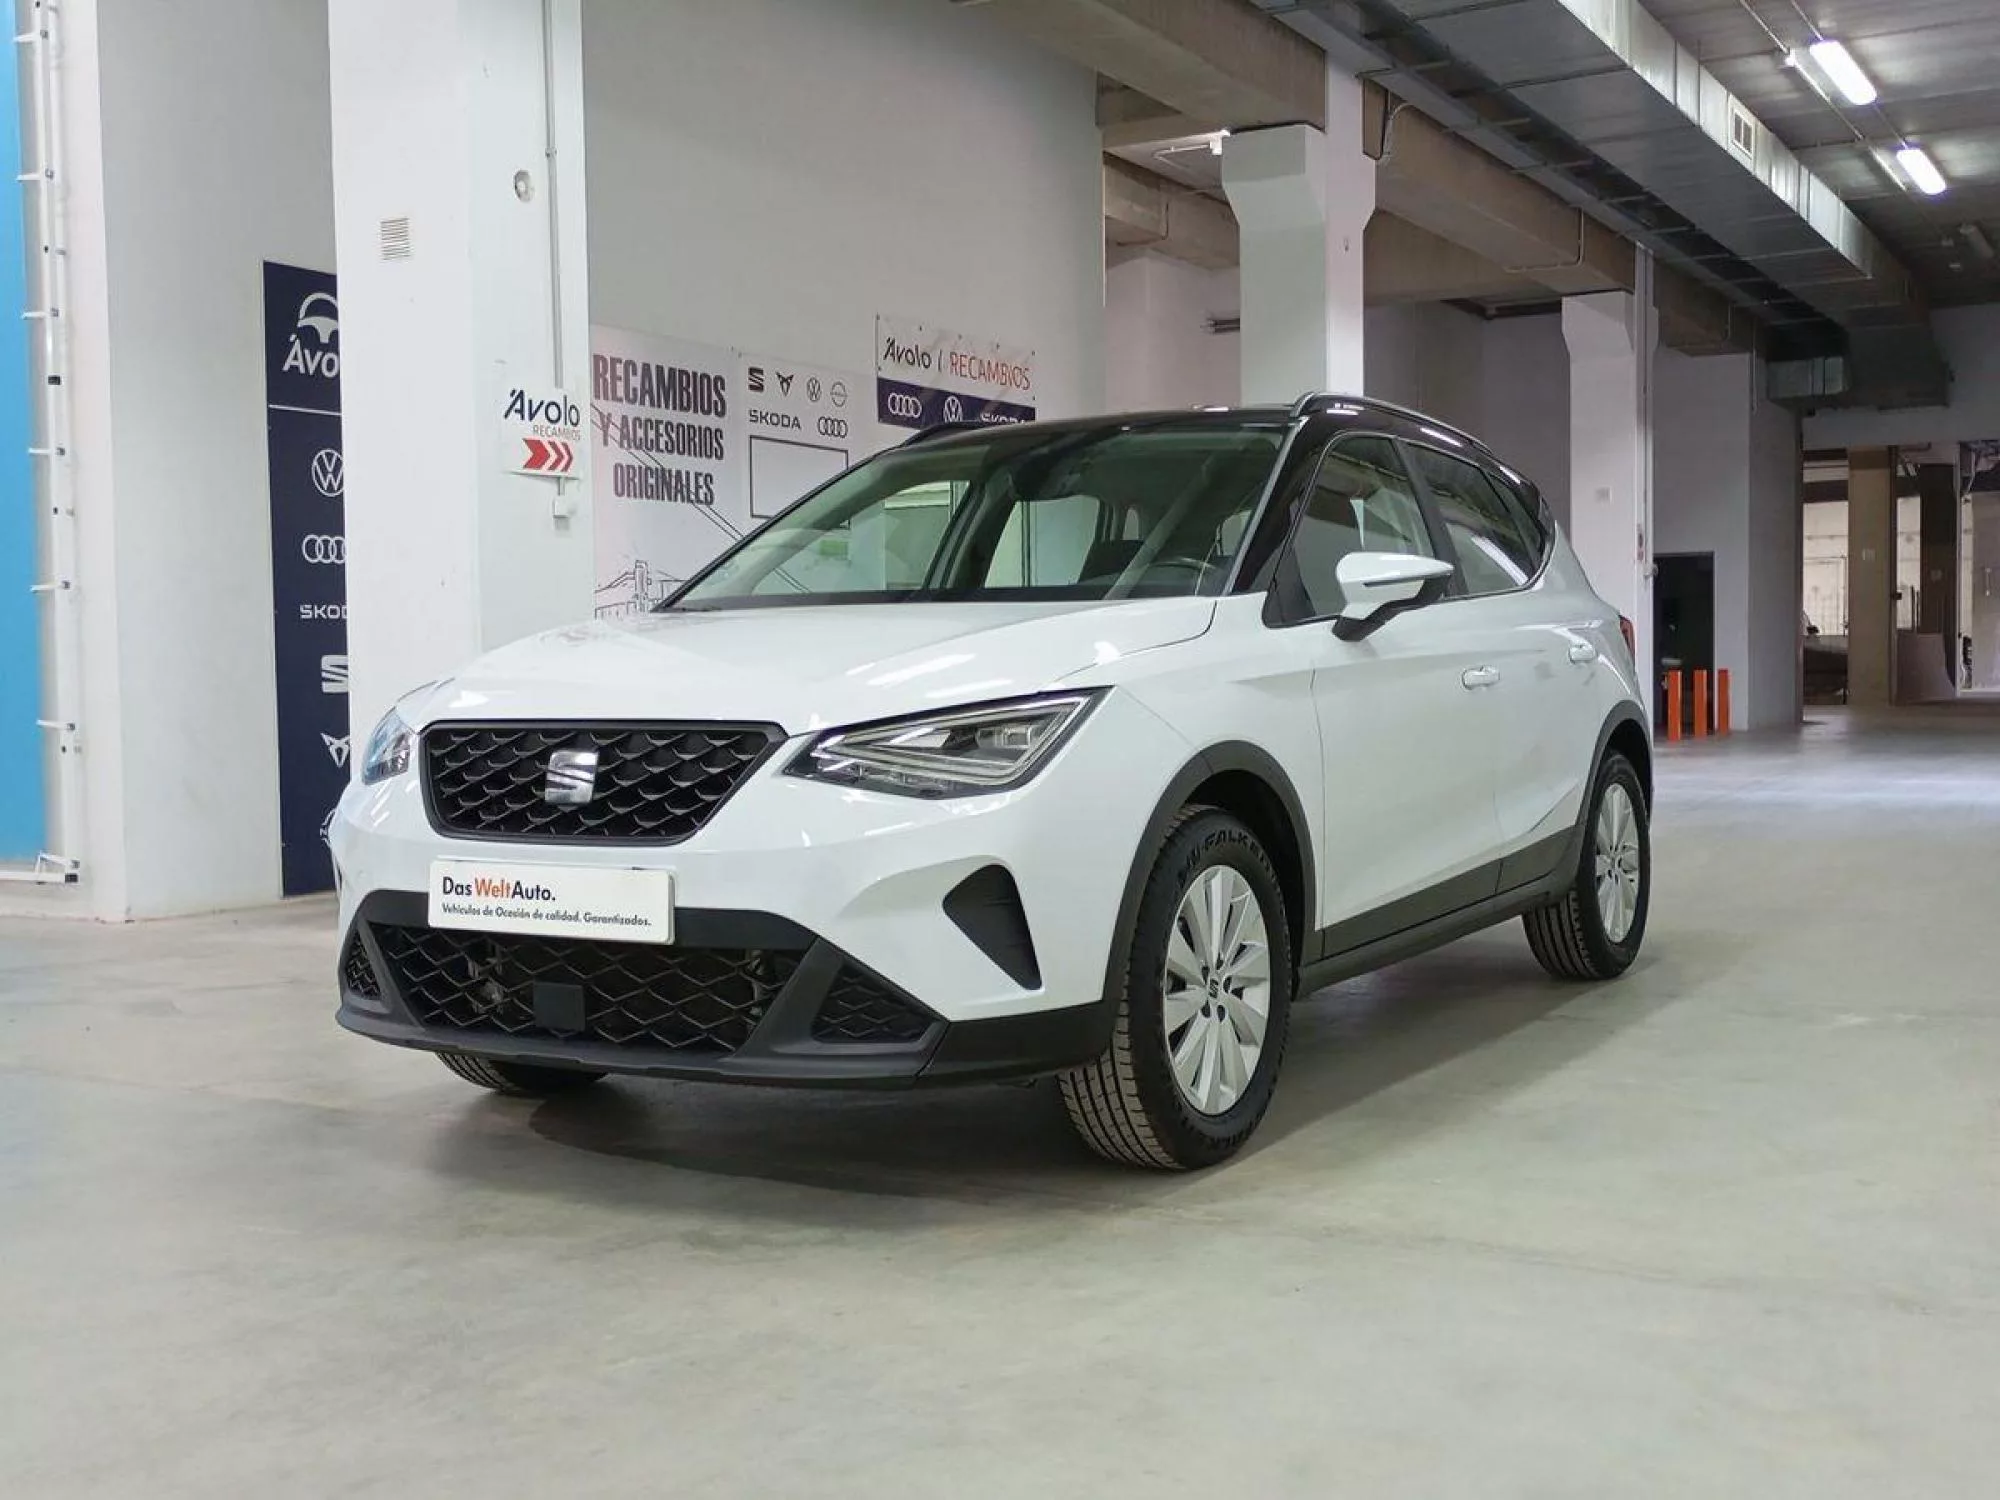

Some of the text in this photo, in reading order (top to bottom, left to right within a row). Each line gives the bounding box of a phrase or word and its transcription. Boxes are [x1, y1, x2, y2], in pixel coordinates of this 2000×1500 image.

[593, 354, 726, 418] RECAMBIOS
[950, 351, 1031, 391] RECAMBIOS
[532, 424, 581, 441] RECAMBIOS
[599, 411, 724, 460] Y ACCESORIOS
[613, 462, 715, 506] ORIGINALES
[442, 876, 472, 896] Das
[482, 906, 494, 916] de
[533, 909, 544, 920] de
